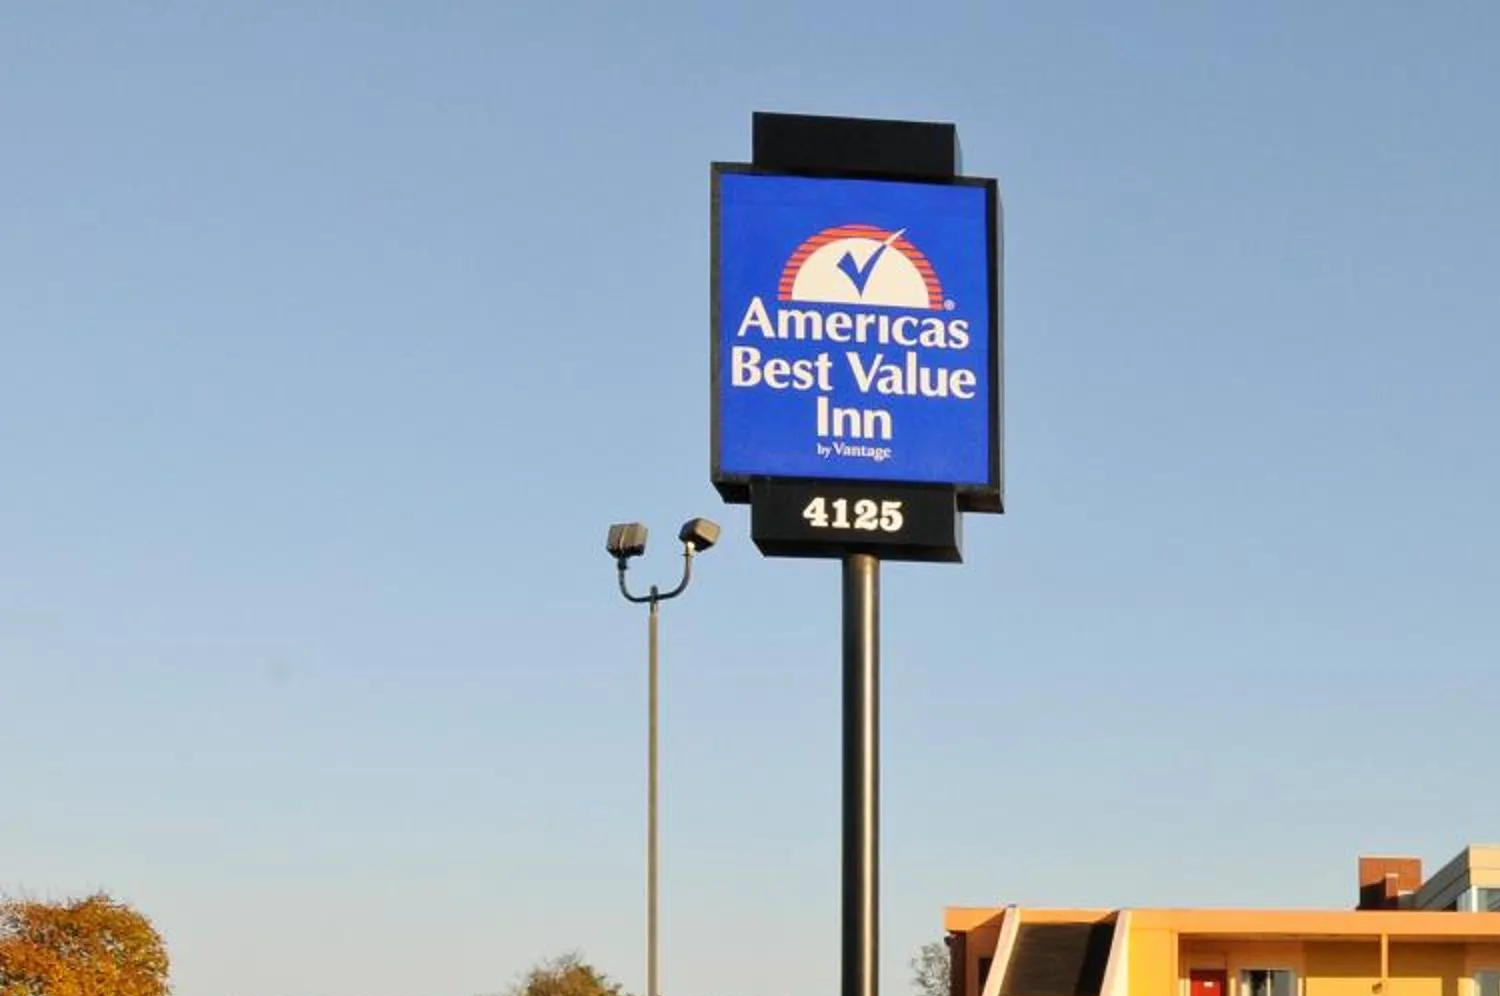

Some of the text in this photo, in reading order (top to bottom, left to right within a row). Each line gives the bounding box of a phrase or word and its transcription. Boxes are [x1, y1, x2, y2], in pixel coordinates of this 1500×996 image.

[737, 296, 970, 350] Americas
[731, 345, 977, 399] Best Value
[816, 396, 892, 440] Inn
[817, 442, 892, 462] by Vantage
[802, 497, 904, 532] 4125
